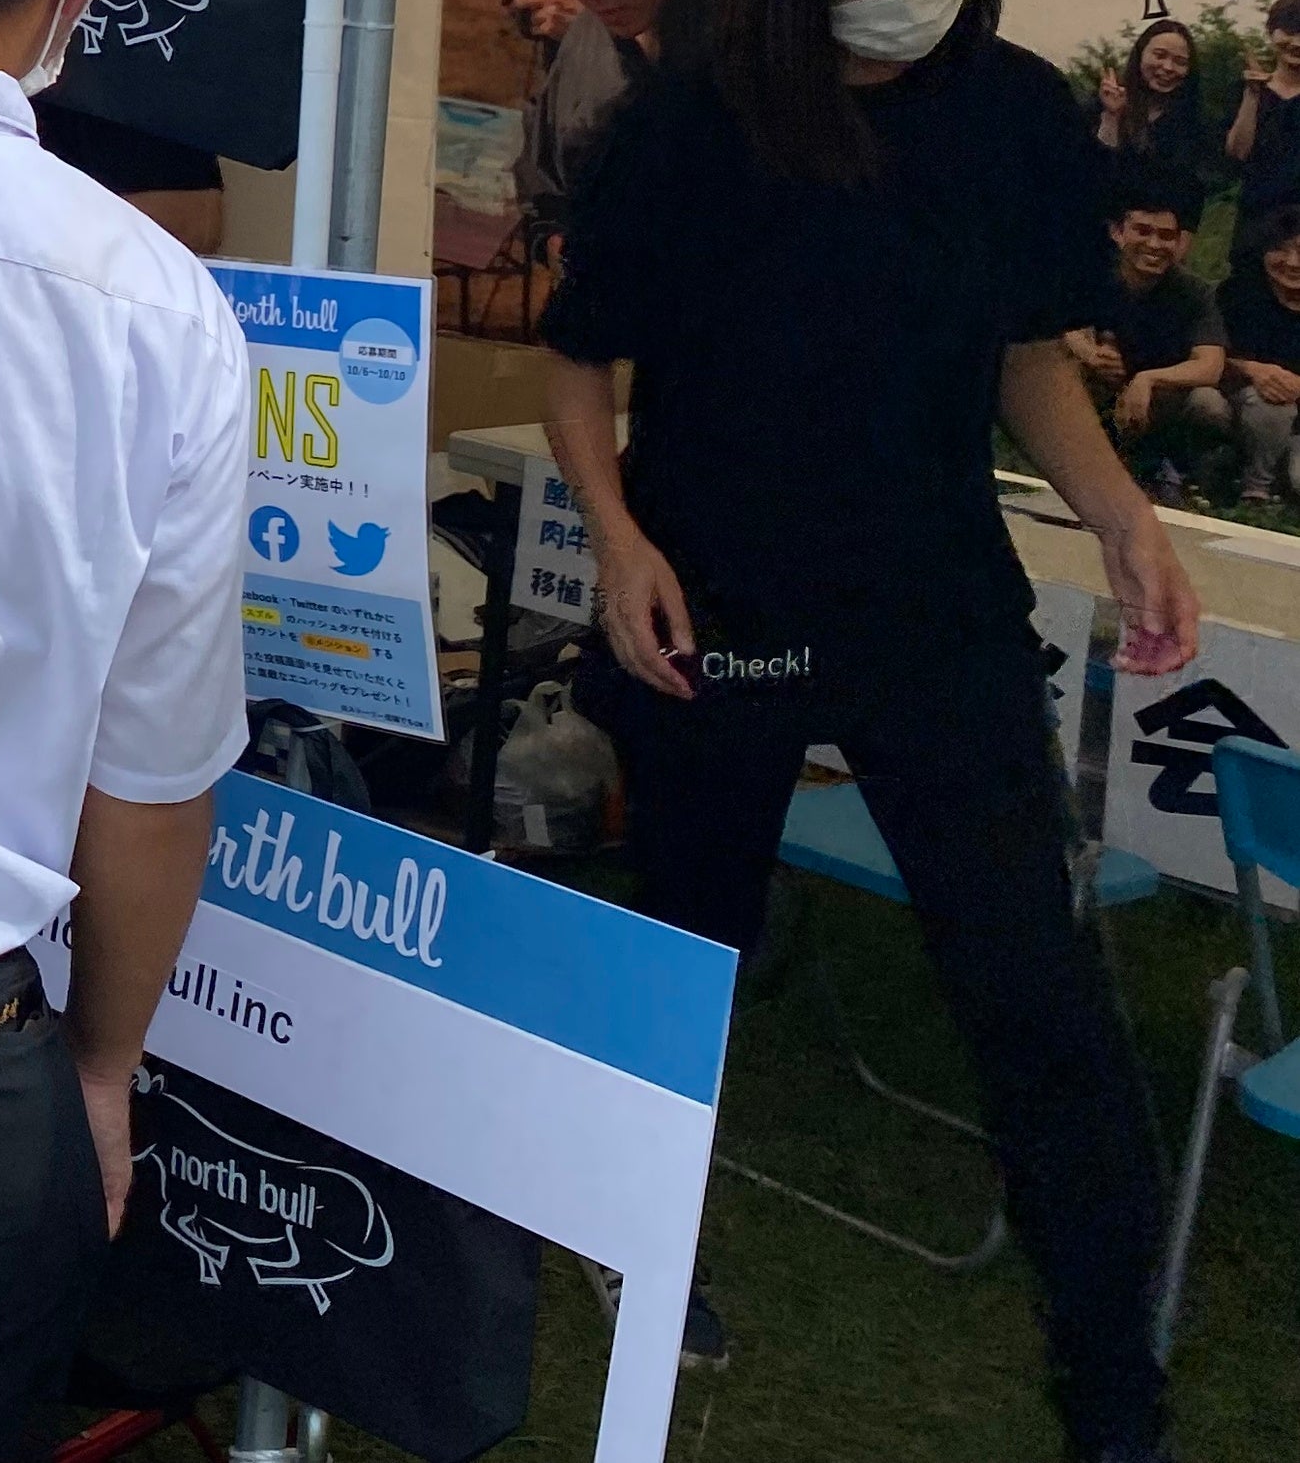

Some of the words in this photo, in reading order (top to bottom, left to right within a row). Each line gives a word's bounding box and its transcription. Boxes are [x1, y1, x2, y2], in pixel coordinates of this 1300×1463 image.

[230, 293, 286, 327] orth
[291, 296, 338, 333] bull
[539, 520, 591, 554] 肉牛
[702, 646, 810, 678] Check!
[209, 808, 313, 913] rth
[317, 829, 447, 968] bull
[171, 1145, 247, 1204] north
[259, 1169, 316, 1229] bull
